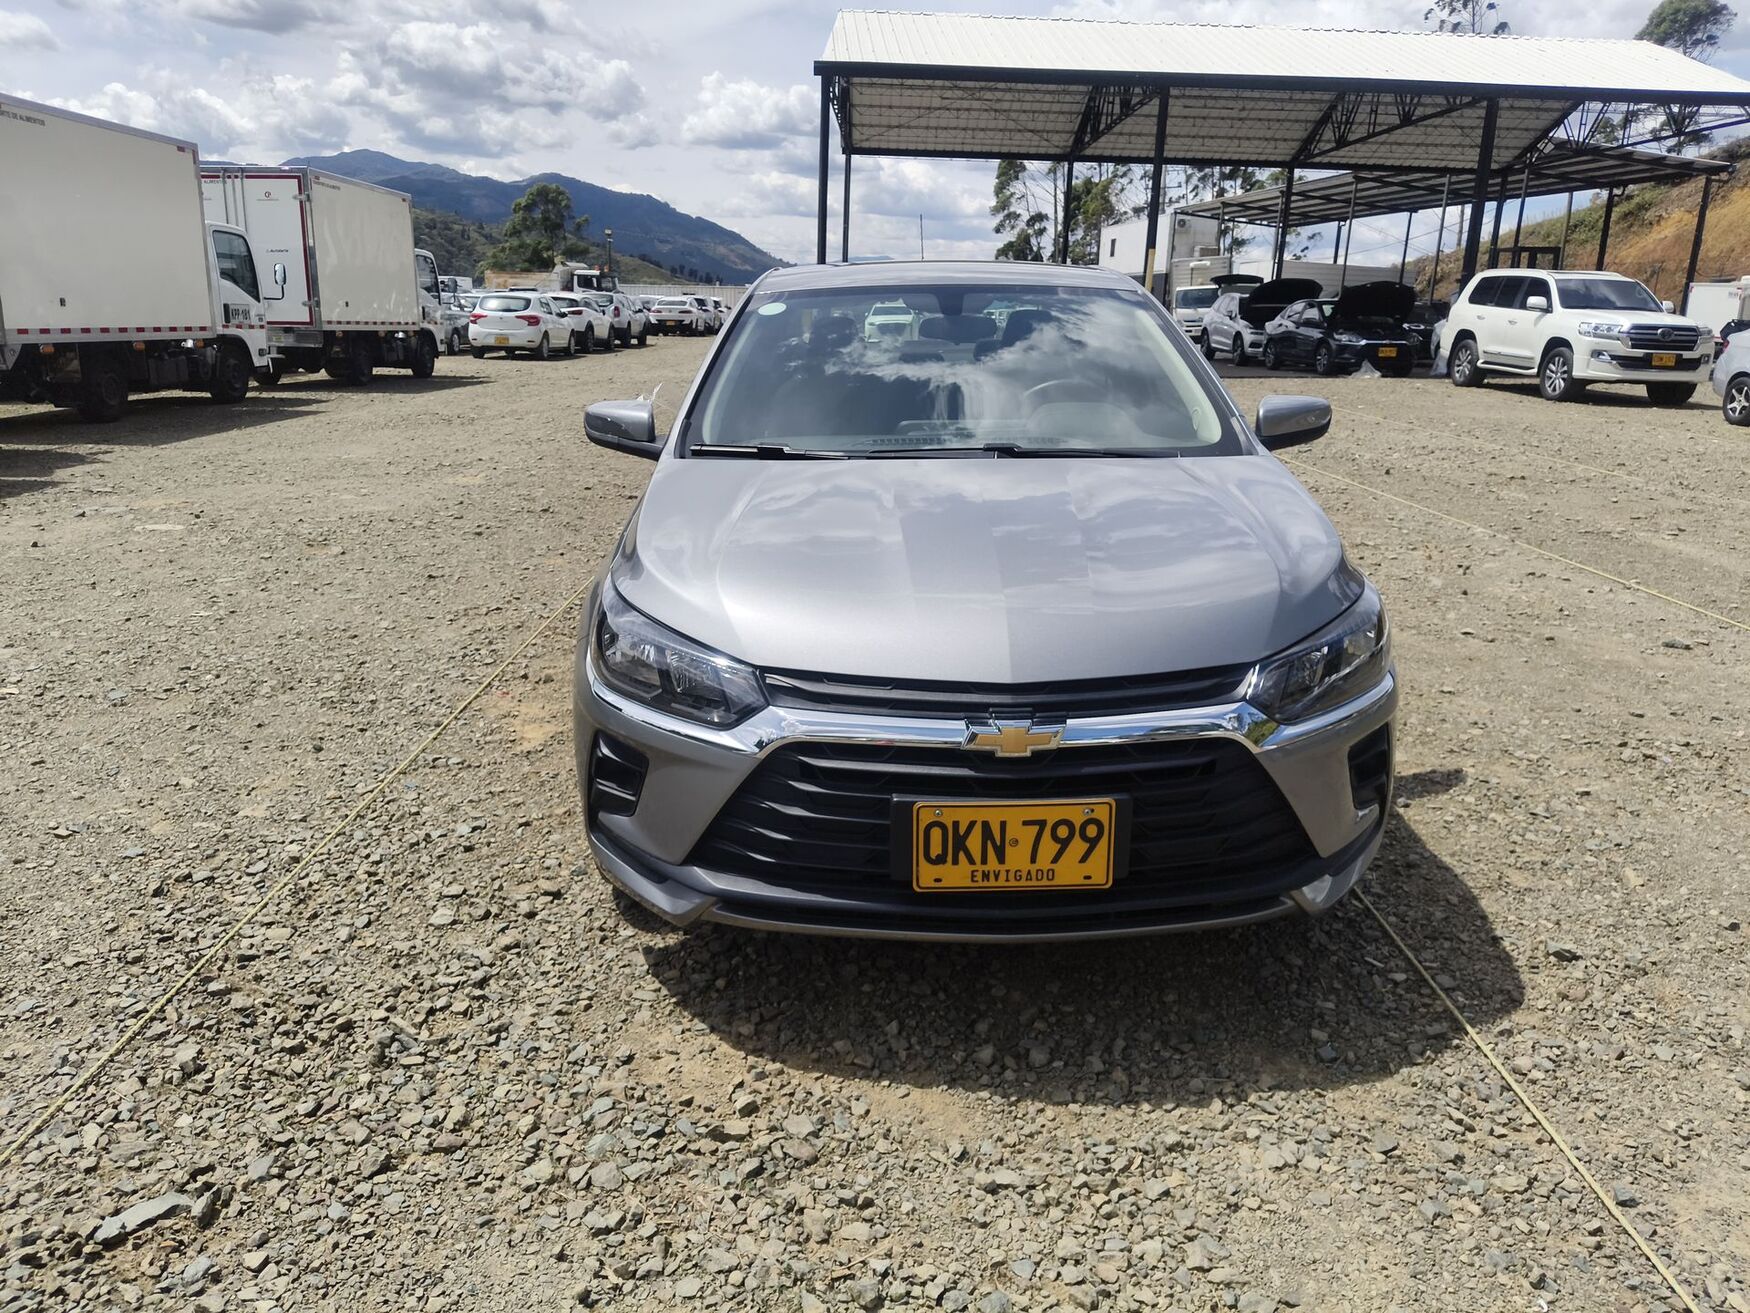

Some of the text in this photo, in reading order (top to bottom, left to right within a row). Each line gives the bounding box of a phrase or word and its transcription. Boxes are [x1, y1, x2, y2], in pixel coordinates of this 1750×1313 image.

[19, 114, 46, 126] ALIMENTOS
[922, 817, 1105, 866] QKN 799
[970, 868, 1056, 883] ENVIGADO
